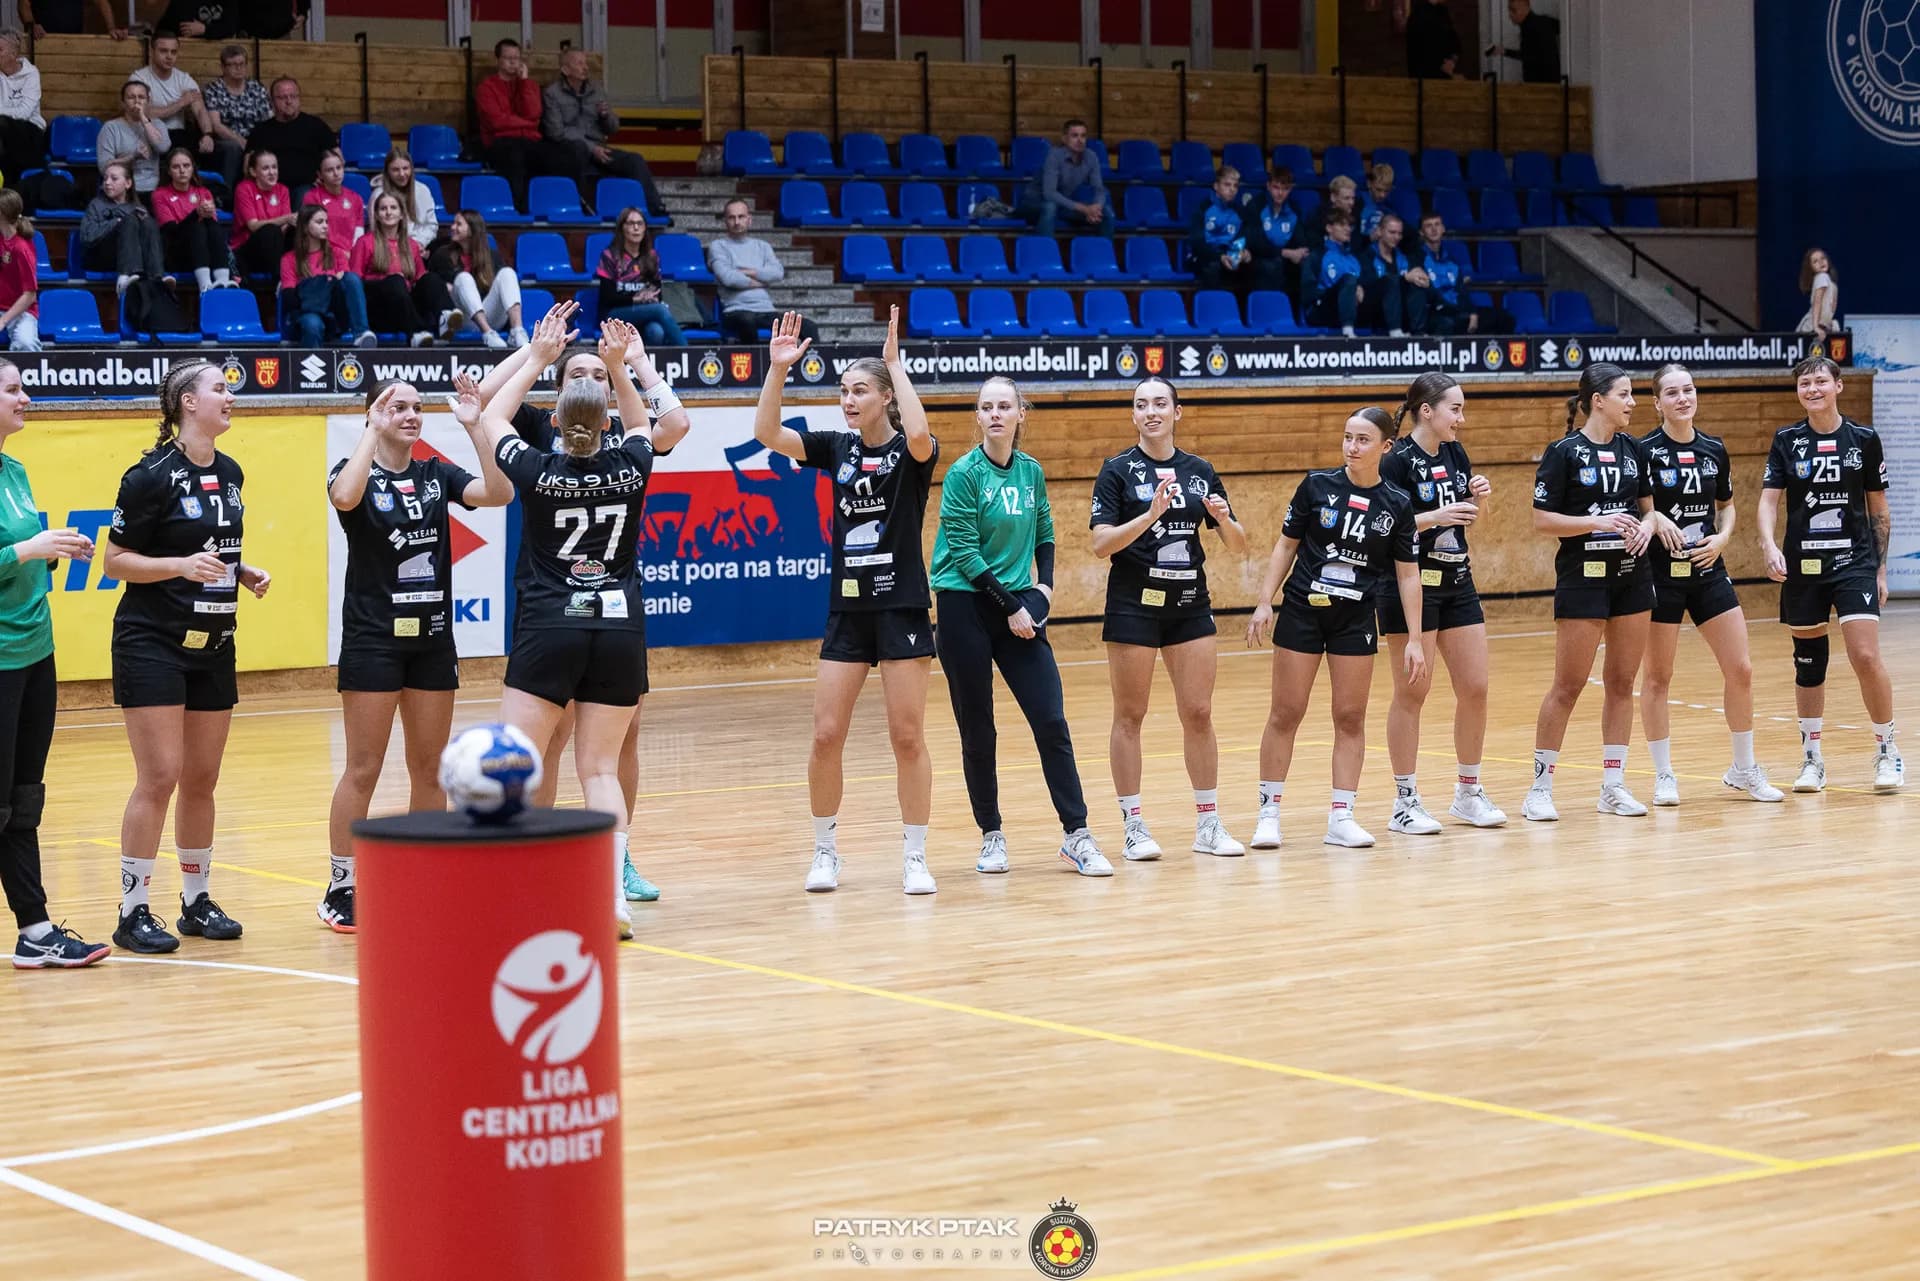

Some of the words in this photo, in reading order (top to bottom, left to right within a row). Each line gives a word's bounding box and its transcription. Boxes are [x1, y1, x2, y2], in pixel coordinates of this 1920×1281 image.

[1846, 54, 1904, 126] KORONA
[1235, 342, 1477, 372] www.koronahandball.pl
[1588, 338, 1803, 366] www.koronahandball.pl
[537, 471, 580, 488] UKS
[583, 474, 602, 488] 9
[1600, 466, 1621, 494] 17
[1680, 467, 1702, 494] 21
[1812, 455, 1841, 484] 25
[535, 486, 608, 498] HANDBALL
[615, 480, 644, 494] TEAM
[852, 496, 885, 508] STEAM
[1000, 486, 1023, 515] 12
[1165, 483, 1187, 509] 3
[1436, 481, 1457, 508] 15
[1819, 492, 1849, 500] STEAM
[209, 494, 232, 527] 2
[402, 494, 424, 520] 5
[1684, 503, 1710, 512] STEAM
[406, 527, 438, 539] STEAM
[554, 503, 628, 561] 27
[1340, 511, 1367, 543] 14
[219, 537, 242, 547] STEA
[574, 563, 604, 577] eisberg
[684, 561, 739, 585] pora
[743, 559, 772, 578] na
[776, 552, 832, 581] targi.
[454, 597, 491, 623] KI
[642, 591, 693, 616] anie
[523, 1066, 589, 1101] LIGA
[505, 1127, 604, 1170] KOBIET
